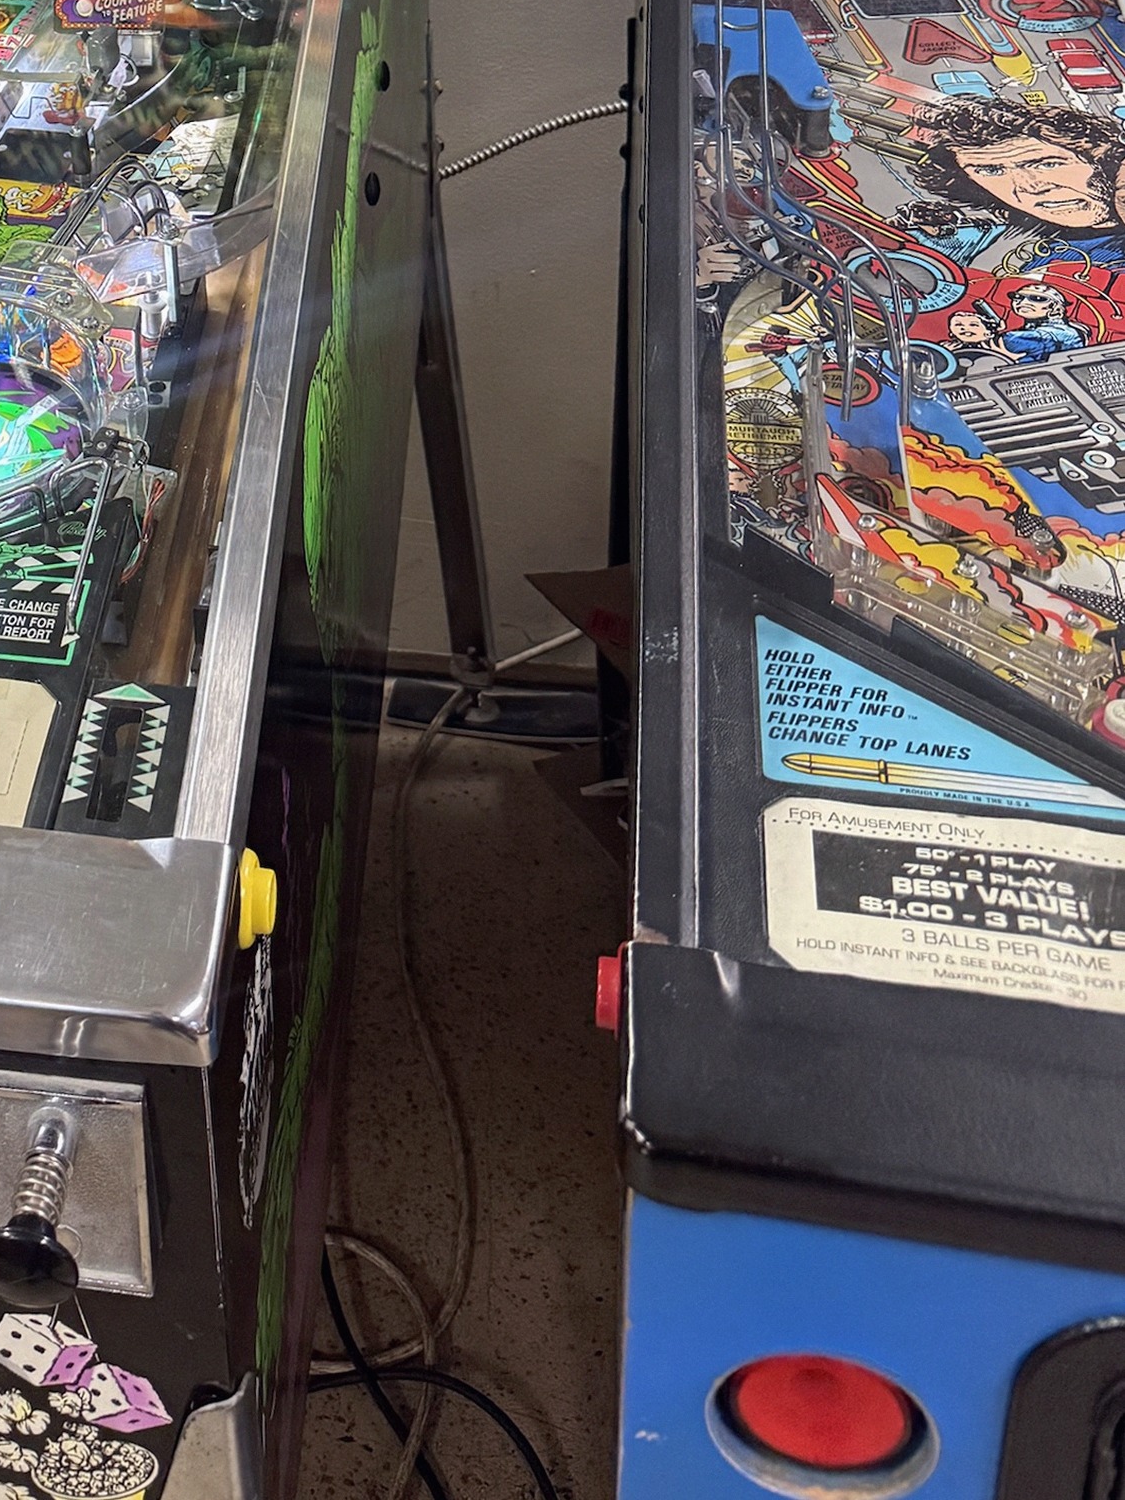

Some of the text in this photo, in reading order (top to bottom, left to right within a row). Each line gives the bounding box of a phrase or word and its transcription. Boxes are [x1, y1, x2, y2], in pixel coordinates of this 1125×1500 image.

[112, 0, 163, 24] FEATURE
[8, 599, 60, 614] CHANGE
[4, 627, 53, 641] REPORT
[29, 615, 56, 629] FOR
[764, 649, 815, 665] HOLD
[765, 664, 832, 681] EITHER
[765, 678, 889, 702] FLIPPER FOR
[766, 693, 906, 719] INSTANT INFO
[767, 710, 859, 733] FLIPPERS
[768, 726, 971, 761] CHANGE TOP LANES
[900, 787, 940, 797] PROUDLY
[943, 792, 969, 800] MADE
[986, 797, 1003, 805] THE
[973, 854, 986, 867] 1
[990, 855, 1057, 875] PLAY
[966, 869, 984, 883] 2
[990, 873, 1075, 897] PLAYS
[891, 876, 1090, 922] BEST VALUE!
[859, 895, 955, 921] $1.00
[984, 911, 1009, 929] 3
[796, 936, 836, 950] HOLD
[840, 941, 901, 960] INSTANT
[906, 950, 940, 964] INFO
[960, 956, 987, 968] SEE
[902, 928, 1113, 973] 3 BALLS PER GAME
